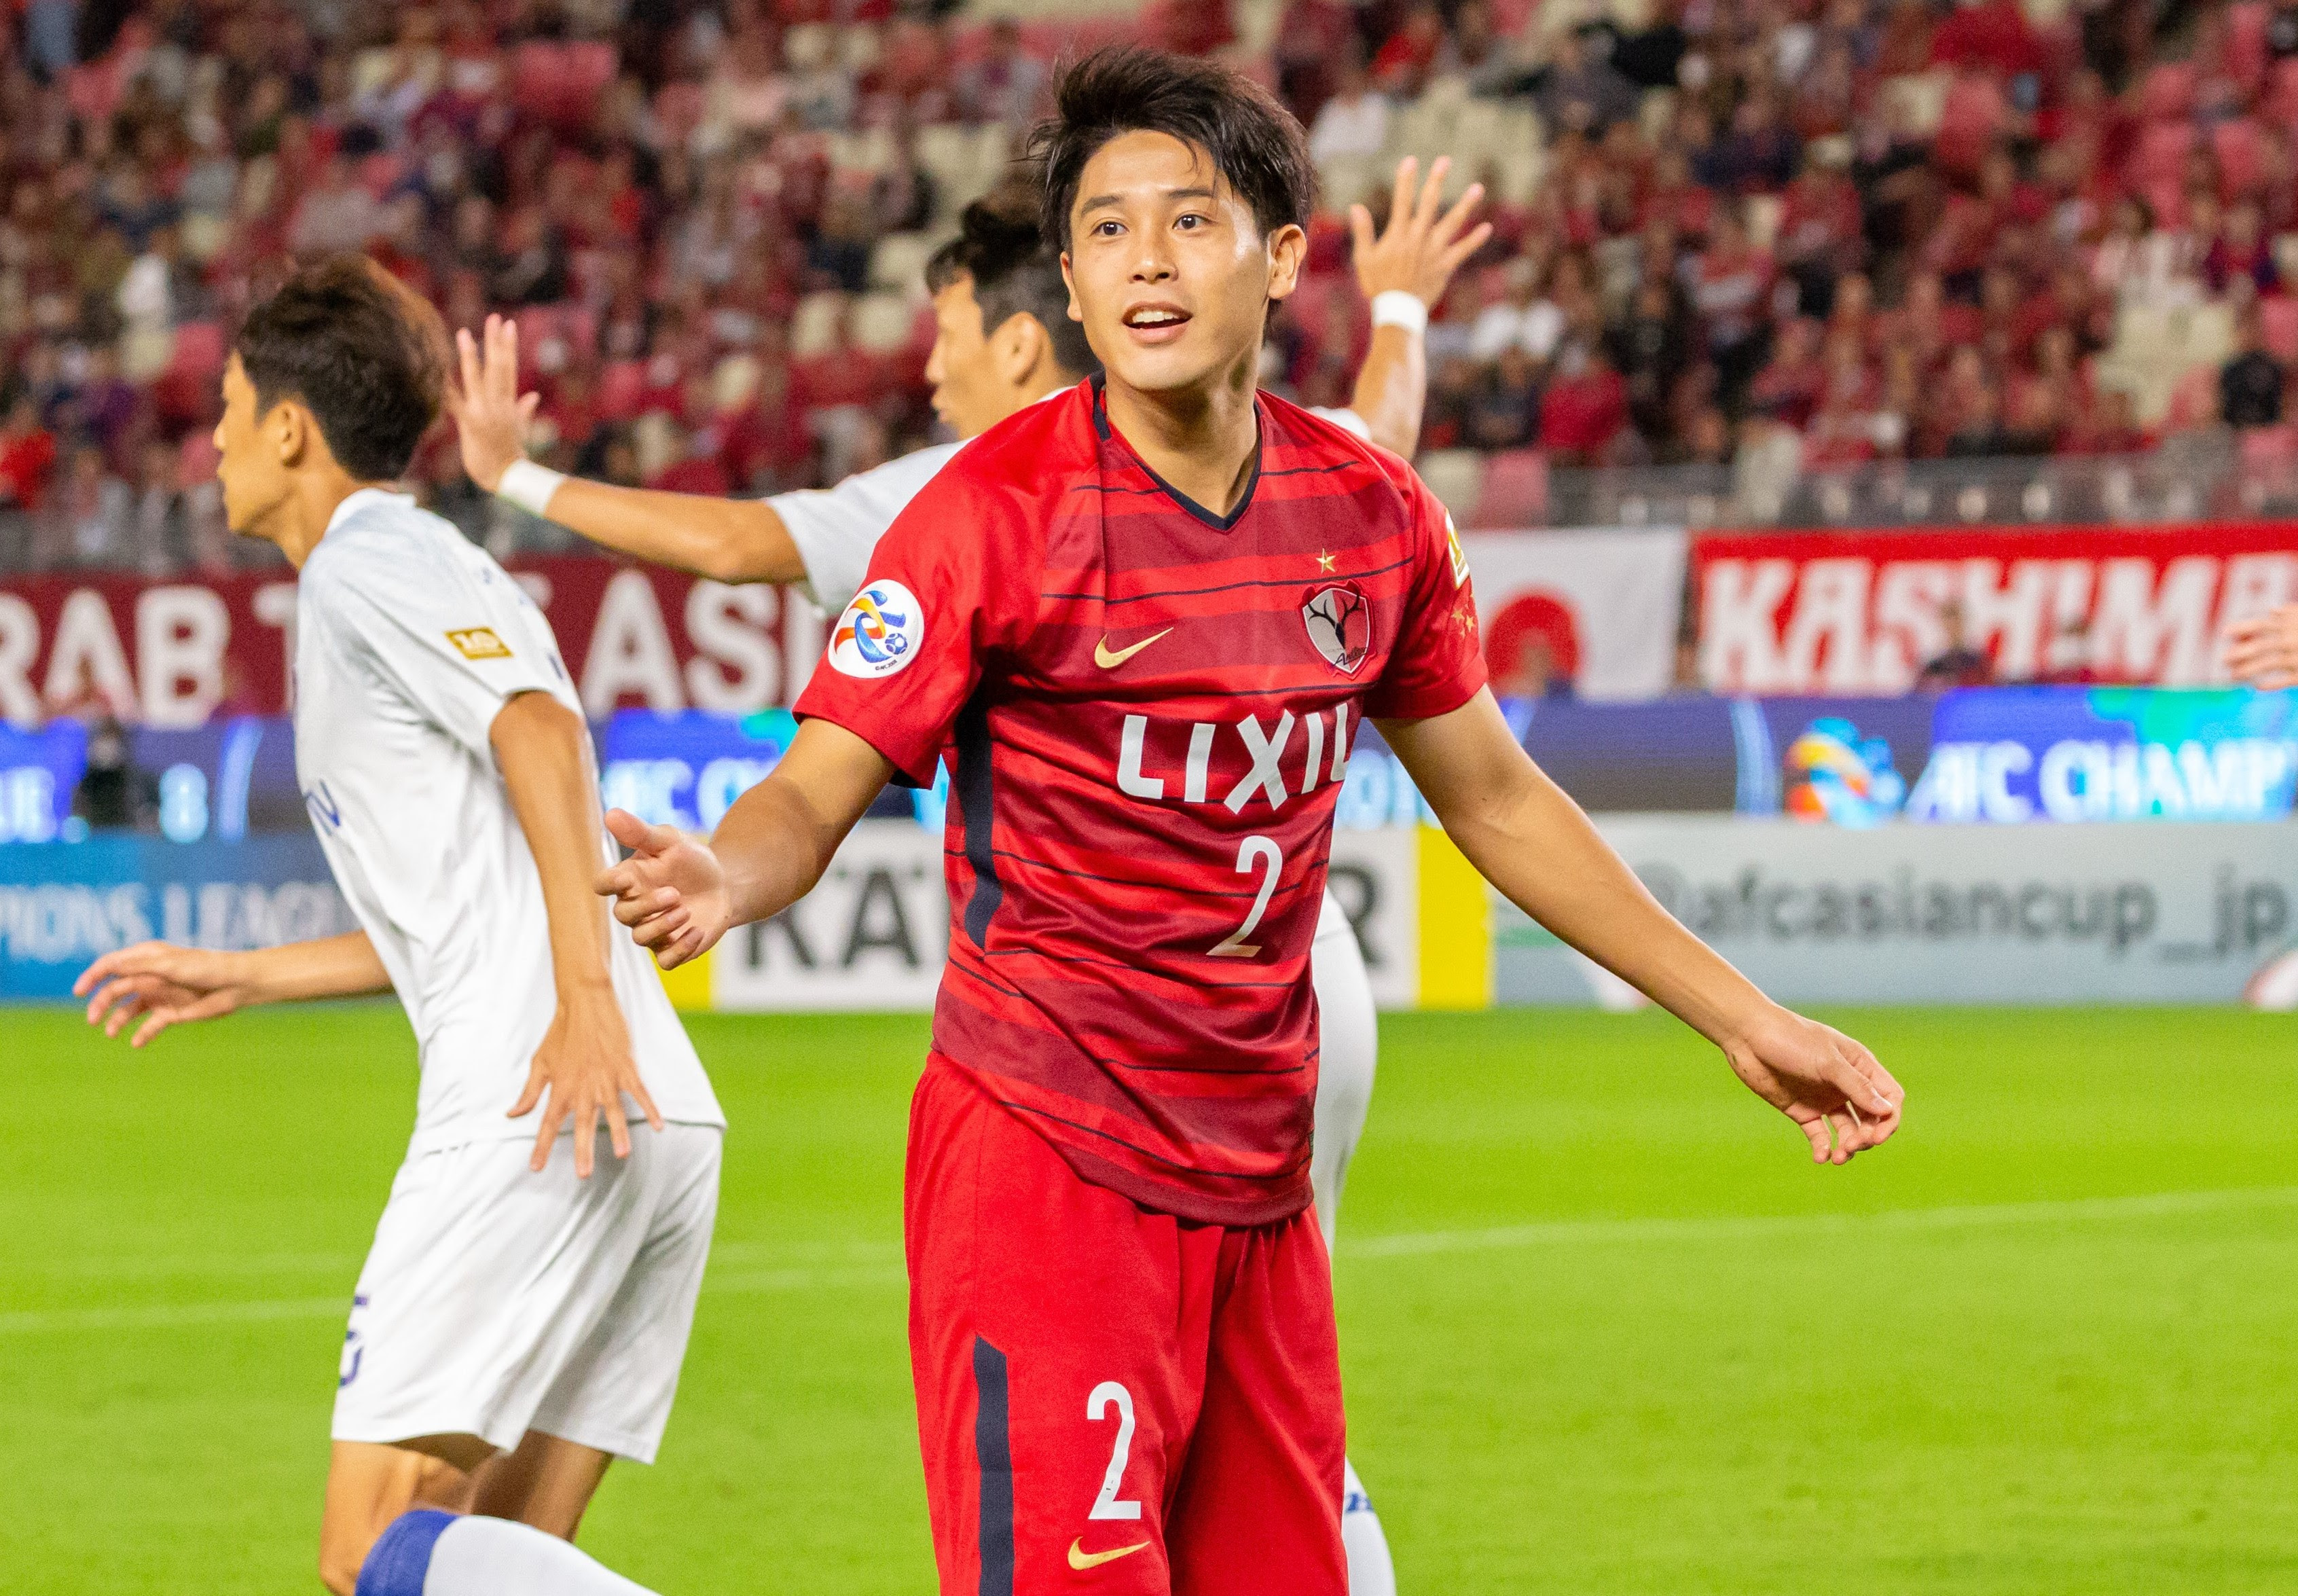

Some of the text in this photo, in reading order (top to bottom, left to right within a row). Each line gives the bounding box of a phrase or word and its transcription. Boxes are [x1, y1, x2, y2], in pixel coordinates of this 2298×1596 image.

[1116, 702, 1351, 816] LIXIL
[1205, 835, 1283, 958] 2
[1087, 1381, 1142, 1520] 2
